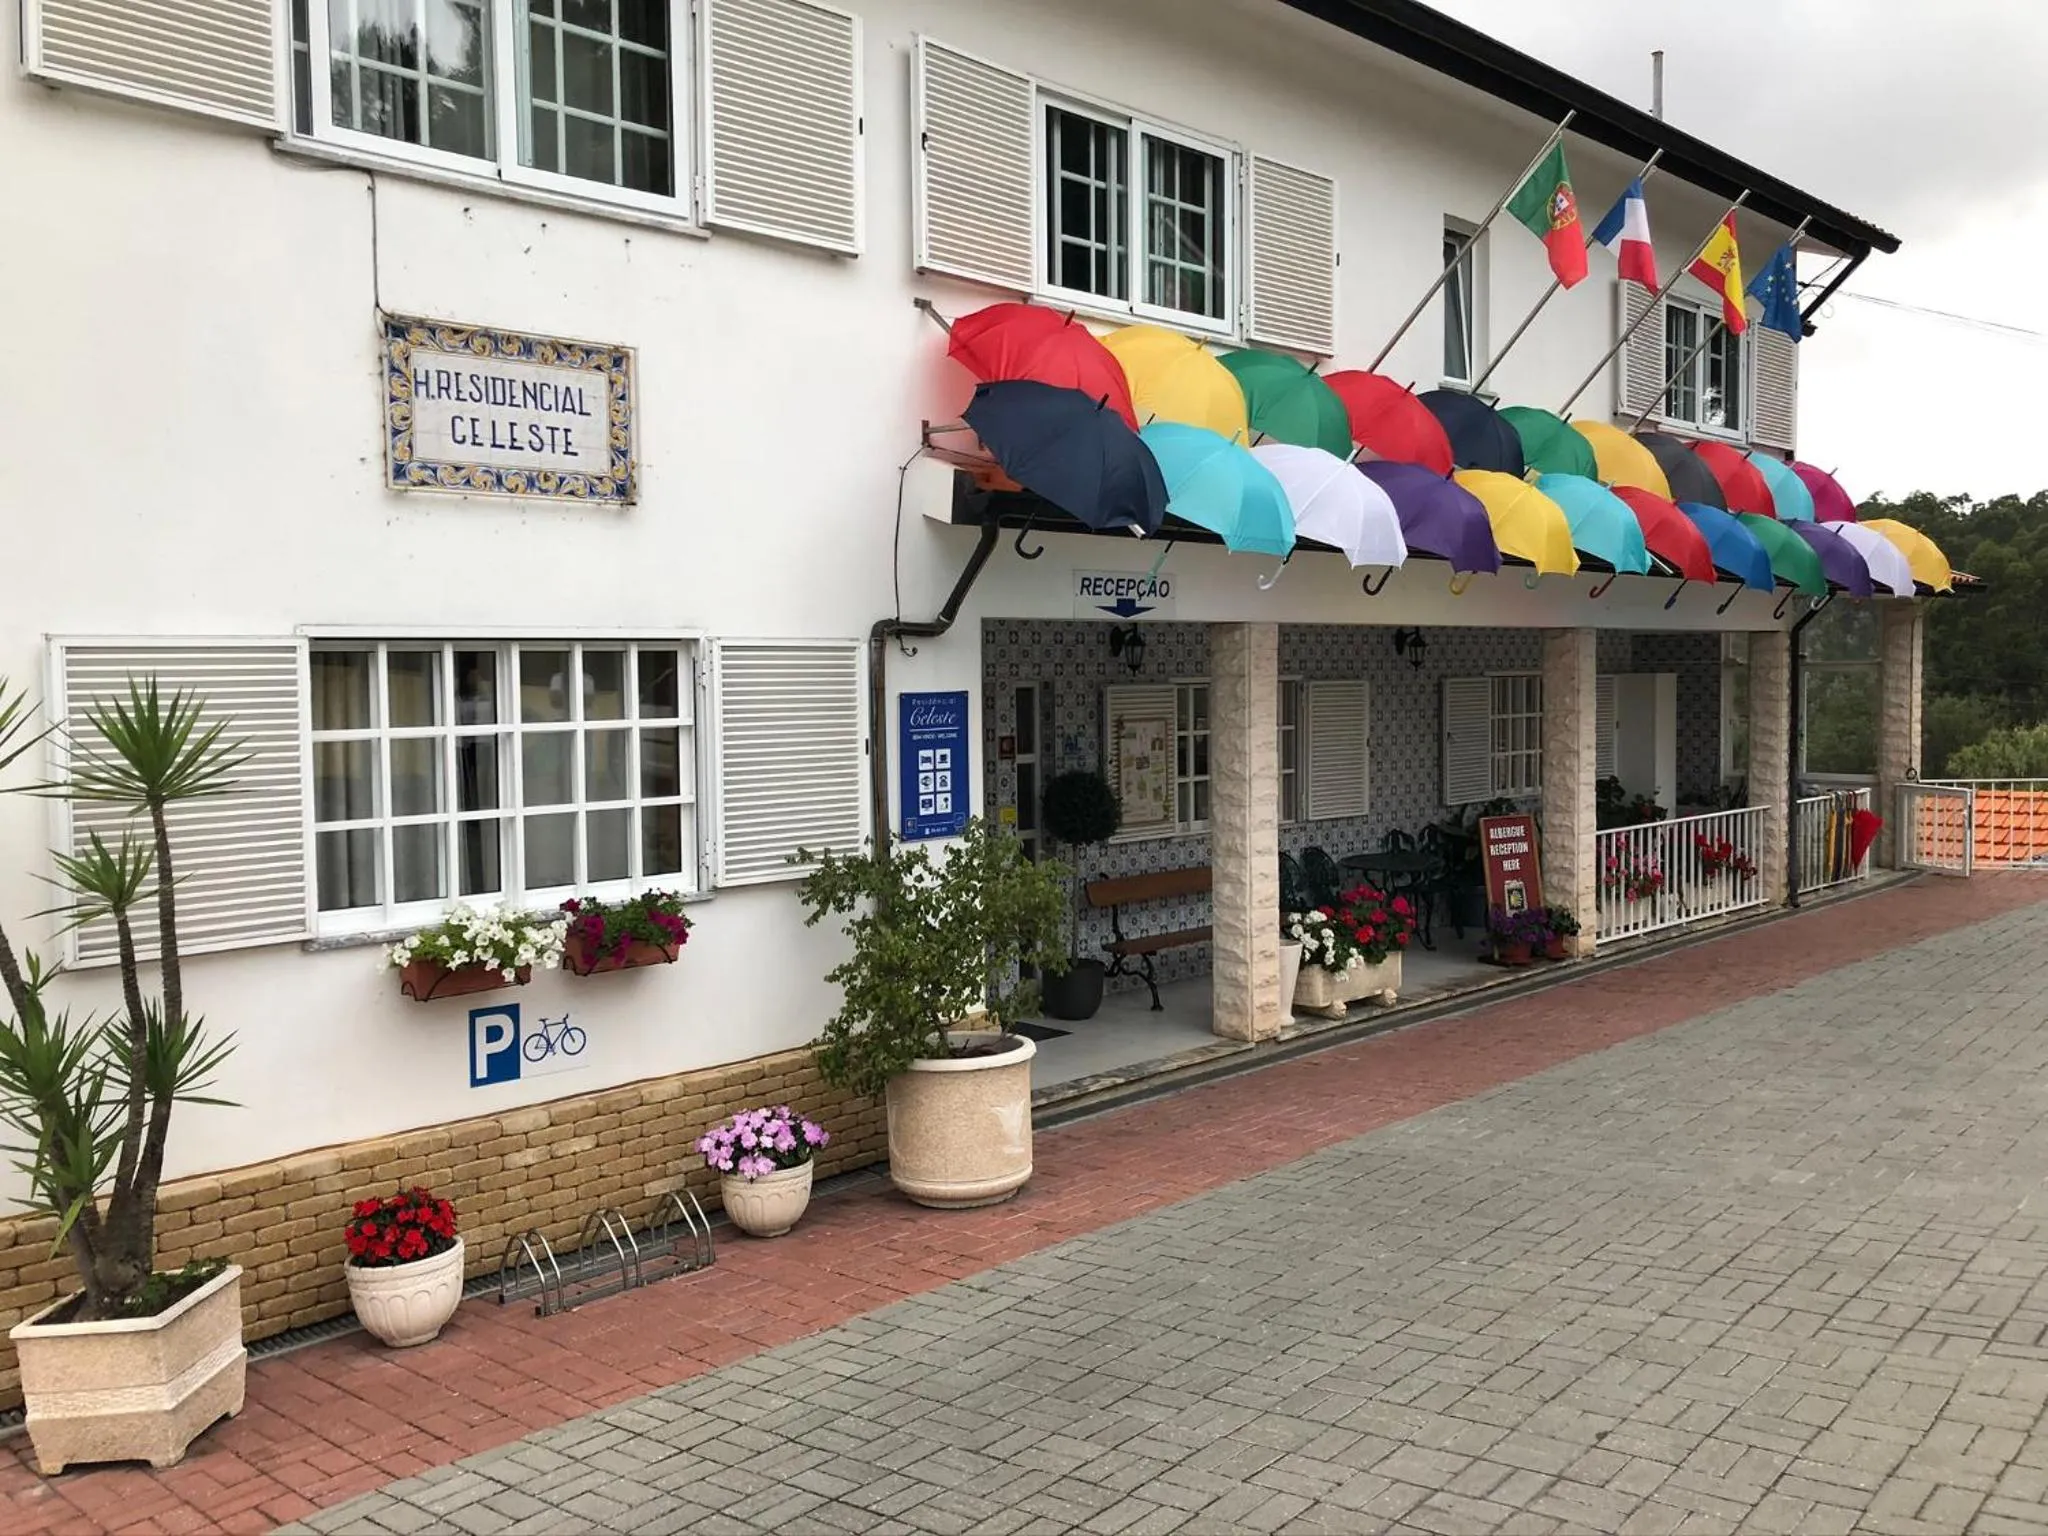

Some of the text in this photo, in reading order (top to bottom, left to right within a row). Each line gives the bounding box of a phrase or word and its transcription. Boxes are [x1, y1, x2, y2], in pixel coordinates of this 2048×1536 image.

[413, 368, 592, 417] H.RESIDENCIAL
[450, 415, 579, 457] CELESTE
[1079, 574, 1171, 601] RECEPÇÃO
[910, 705, 956, 727] Celeste
[1489, 841, 1528, 856] RECEPTION
[1502, 858, 1520, 871] HERE
[475, 1013, 515, 1079] P
